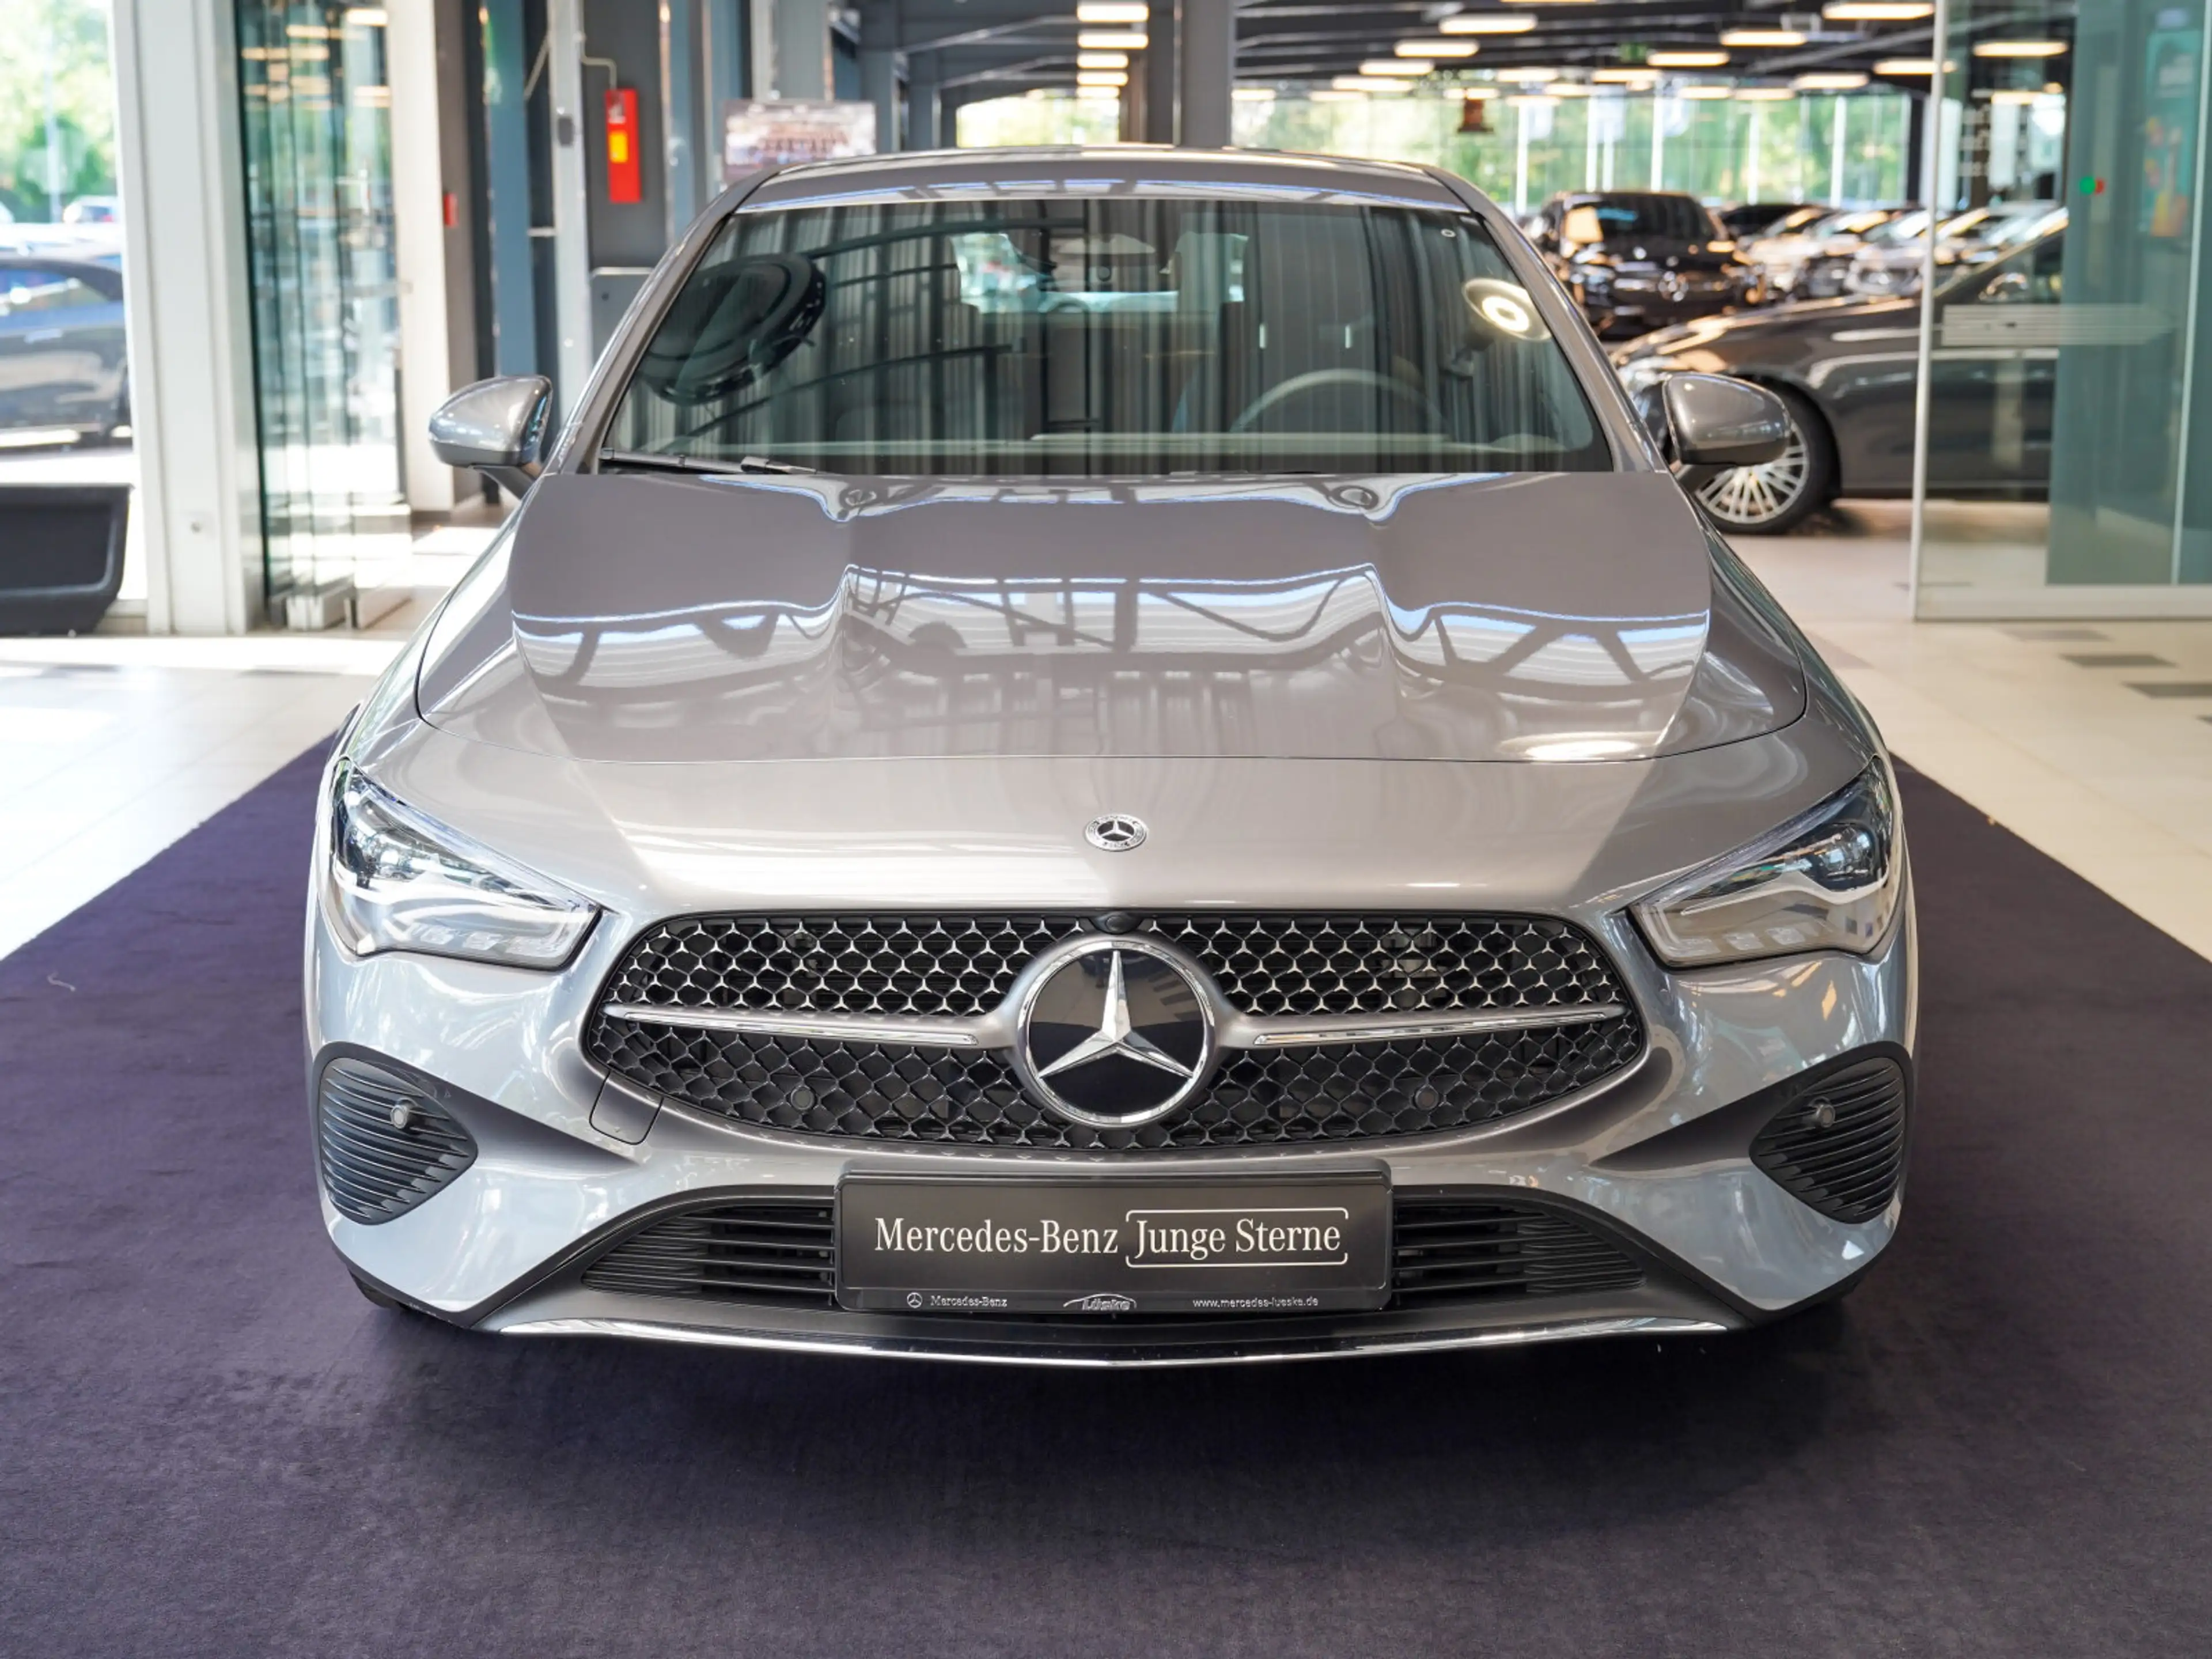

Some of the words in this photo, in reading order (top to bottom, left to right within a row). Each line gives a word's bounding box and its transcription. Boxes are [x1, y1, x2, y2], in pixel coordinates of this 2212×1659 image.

[874, 1217, 1118, 1253] Mercedes-Benz
[1134, 1219, 1226, 1260] Junge
[1236, 1218, 1340, 1252] Sterne
[930, 1295, 1007, 1308] Mercedes-Benz
